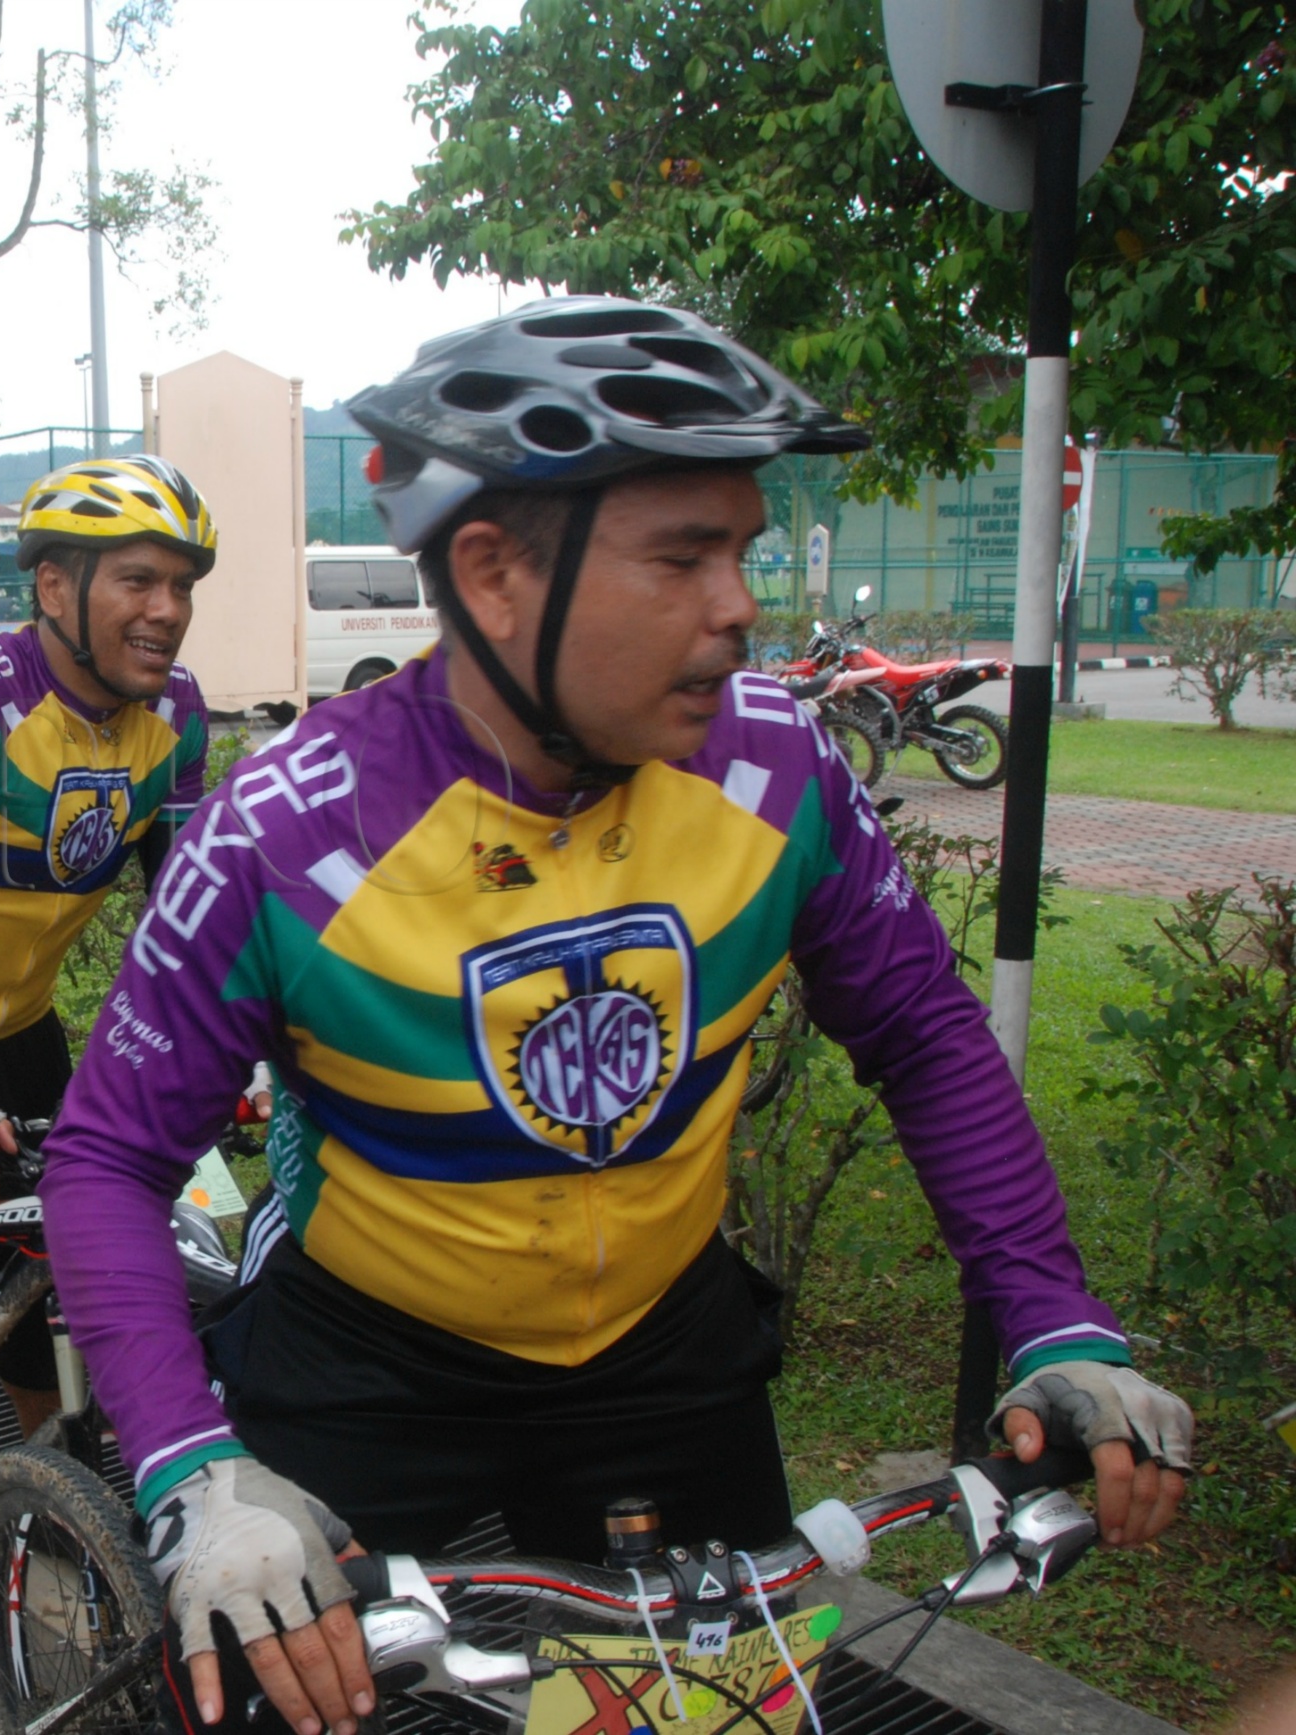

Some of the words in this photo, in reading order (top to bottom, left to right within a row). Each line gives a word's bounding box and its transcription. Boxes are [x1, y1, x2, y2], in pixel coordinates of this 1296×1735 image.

[341, 617, 386, 631] UNIVERSITI
[132, 731, 357, 977] TEKAS
[524, 995, 653, 1124] TEKAS
[695, 1631, 723, 1649] 496
